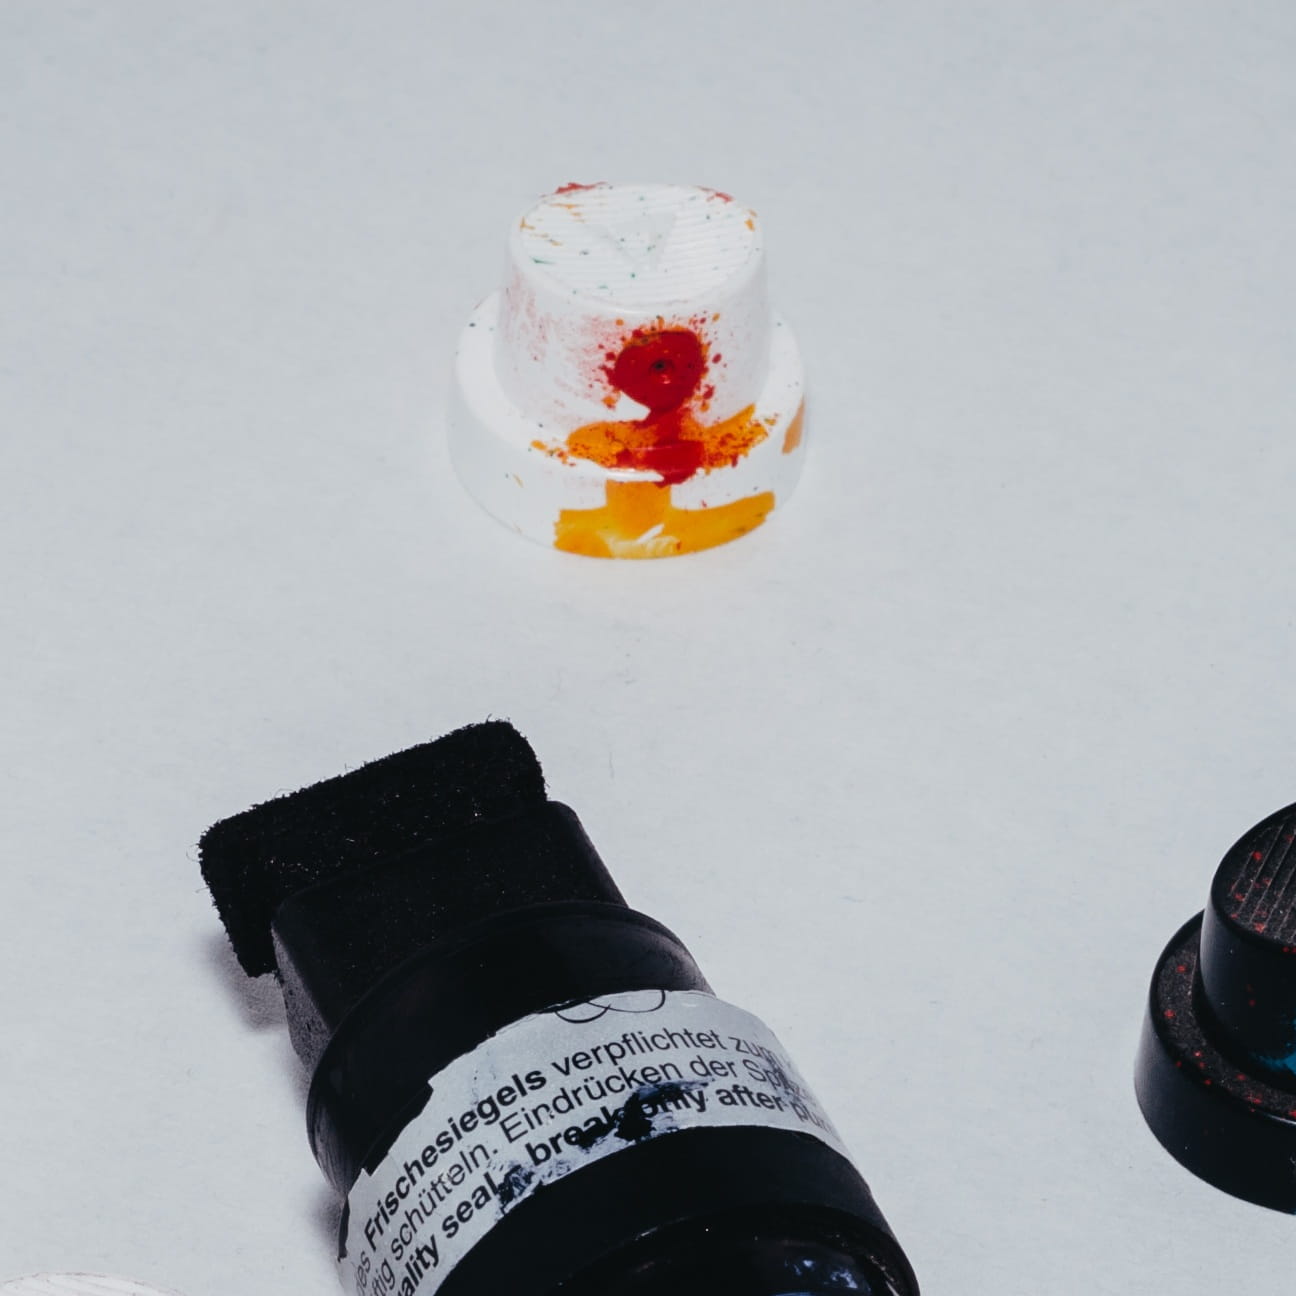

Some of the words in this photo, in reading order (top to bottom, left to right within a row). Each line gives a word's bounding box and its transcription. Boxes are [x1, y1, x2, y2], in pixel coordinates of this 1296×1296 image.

[363, 1068, 548, 1251] Frischesiegels
[551, 1027, 722, 1083] verpflichtet
[389, 1132, 499, 1264] schütteln.
[502, 1059, 683, 1144] Eindrücken
[689, 1055, 737, 1079] der
[440, 1173, 501, 1240] seal
[715, 1084, 785, 1113] after
